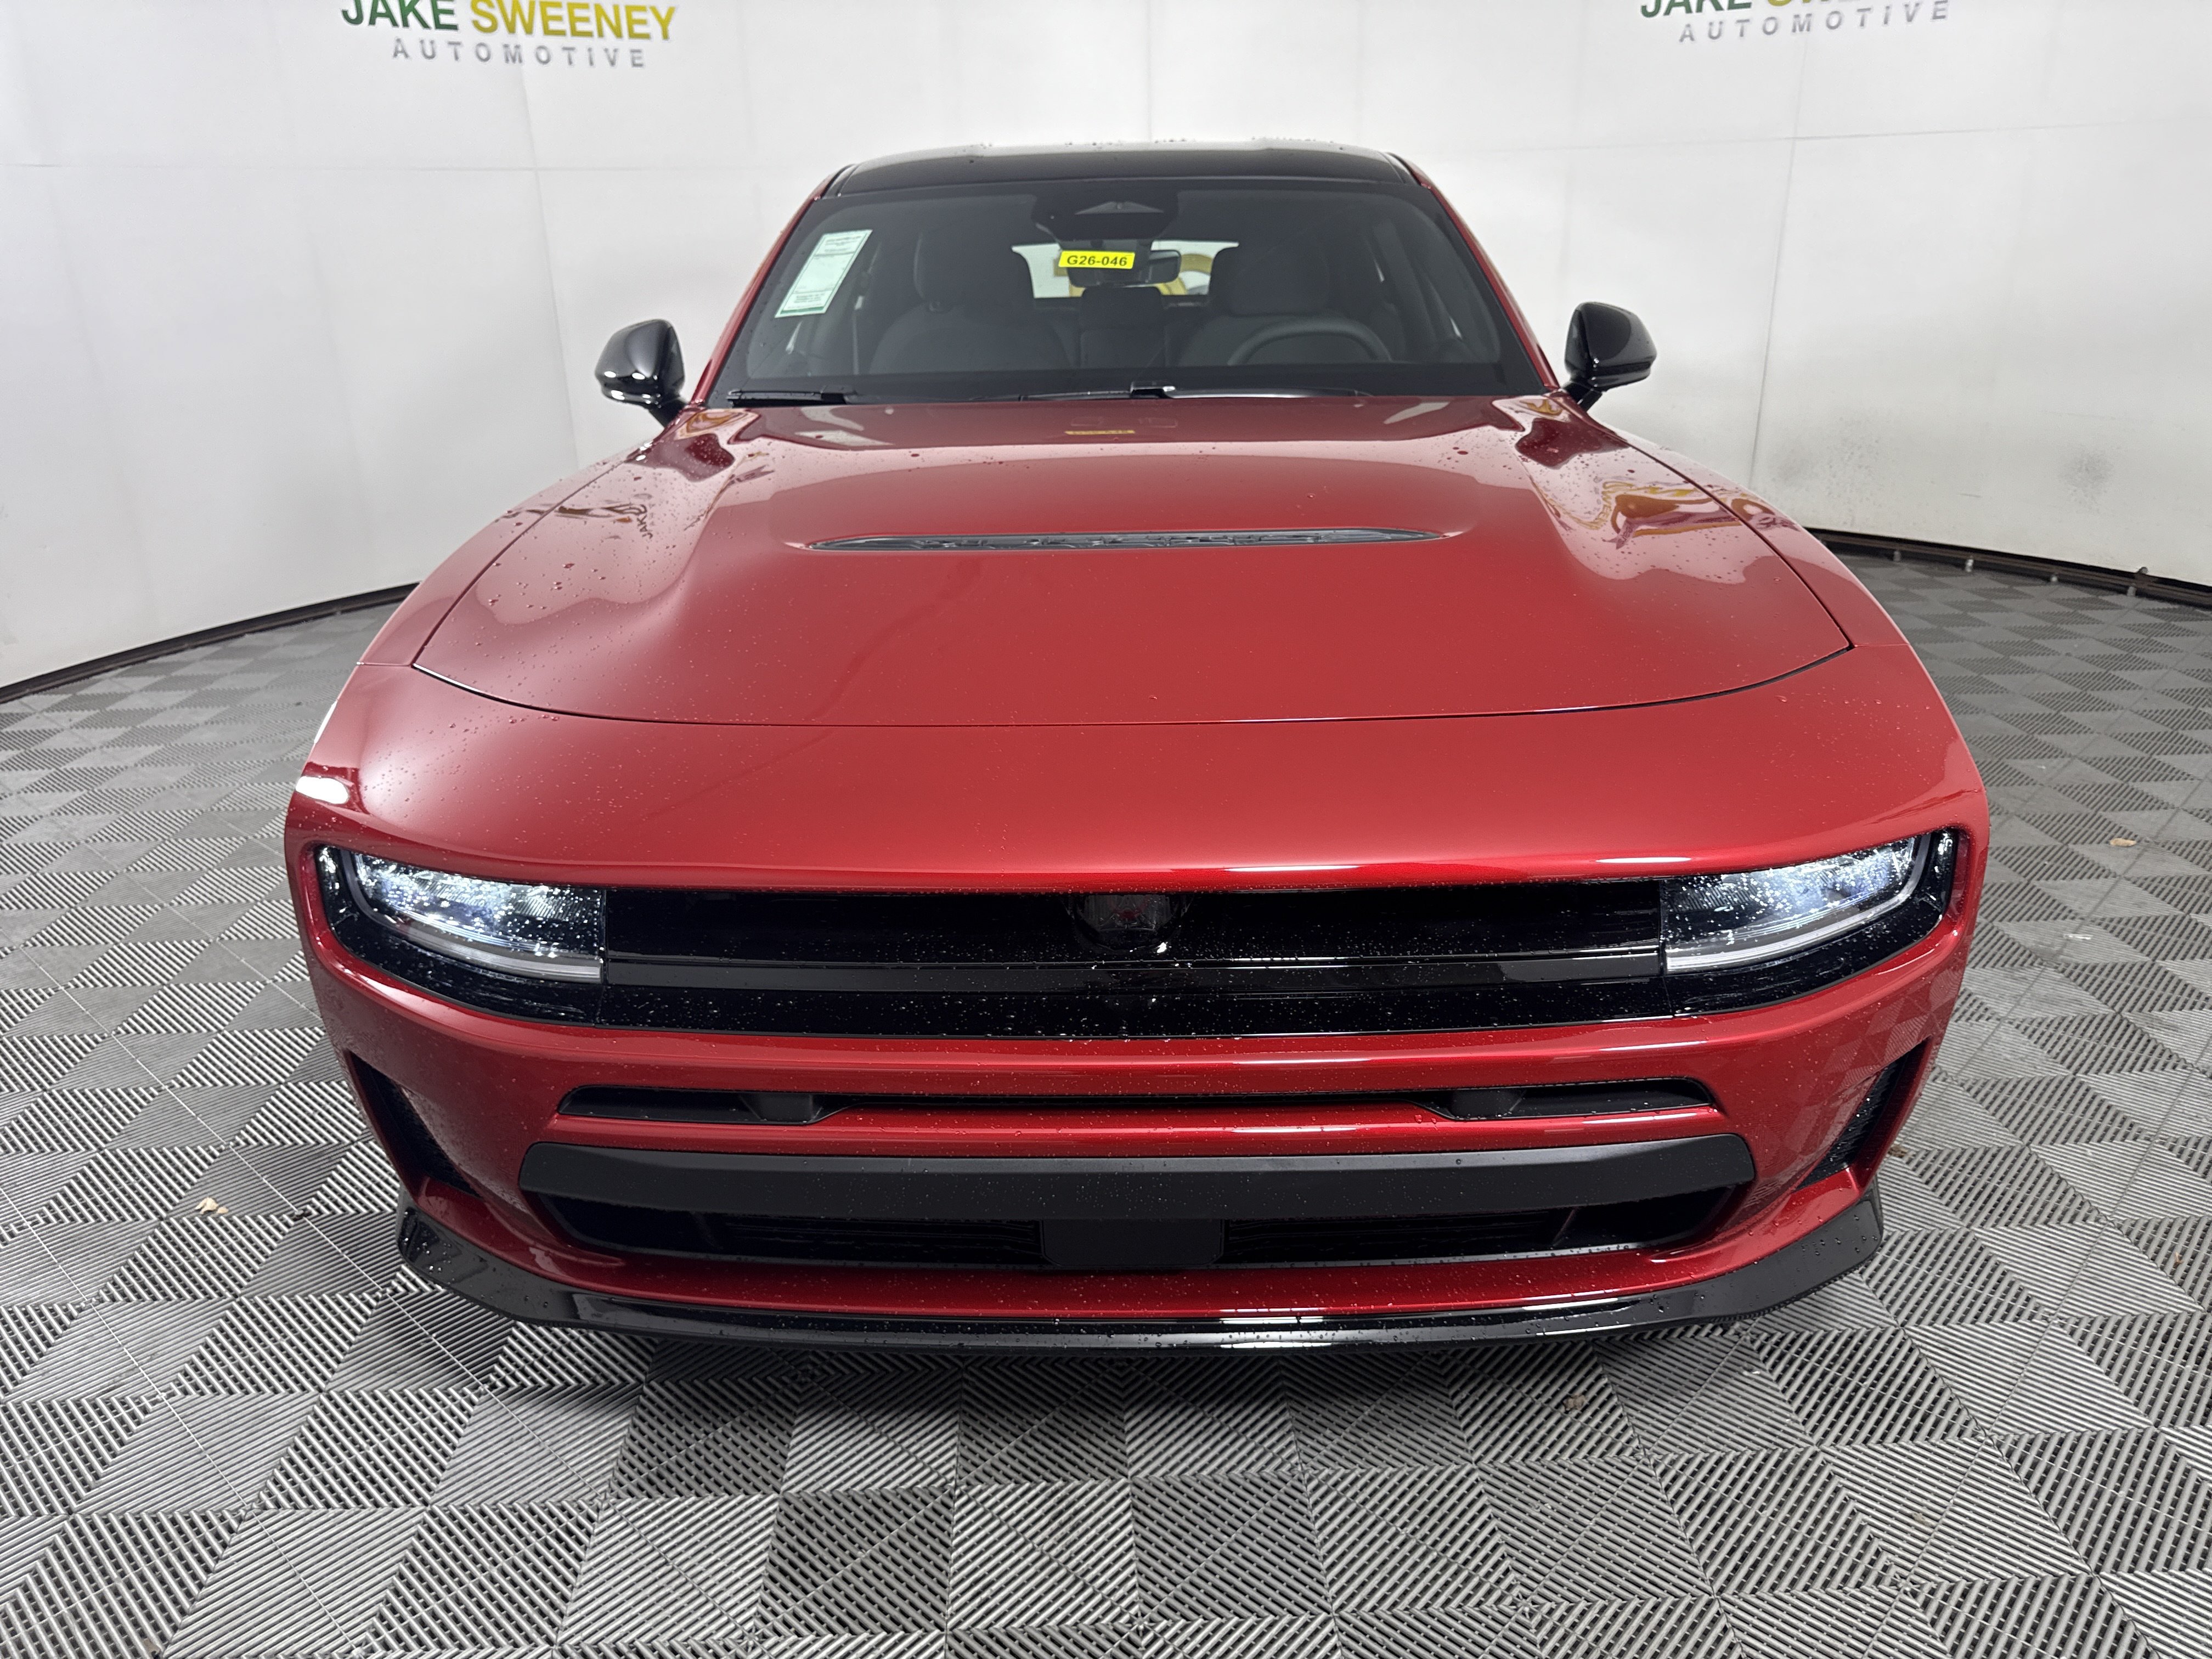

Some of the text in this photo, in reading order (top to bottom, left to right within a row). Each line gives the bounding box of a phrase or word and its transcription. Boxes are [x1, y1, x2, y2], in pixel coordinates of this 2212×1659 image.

[341, 0, 676, 40] JAKE SWEENEY
[1679, 1, 1949, 42] AUTOMOTIVE
[393, 38, 645, 67] AUTOMOTIVE
[1066, 255, 1127, 266] G26-046
